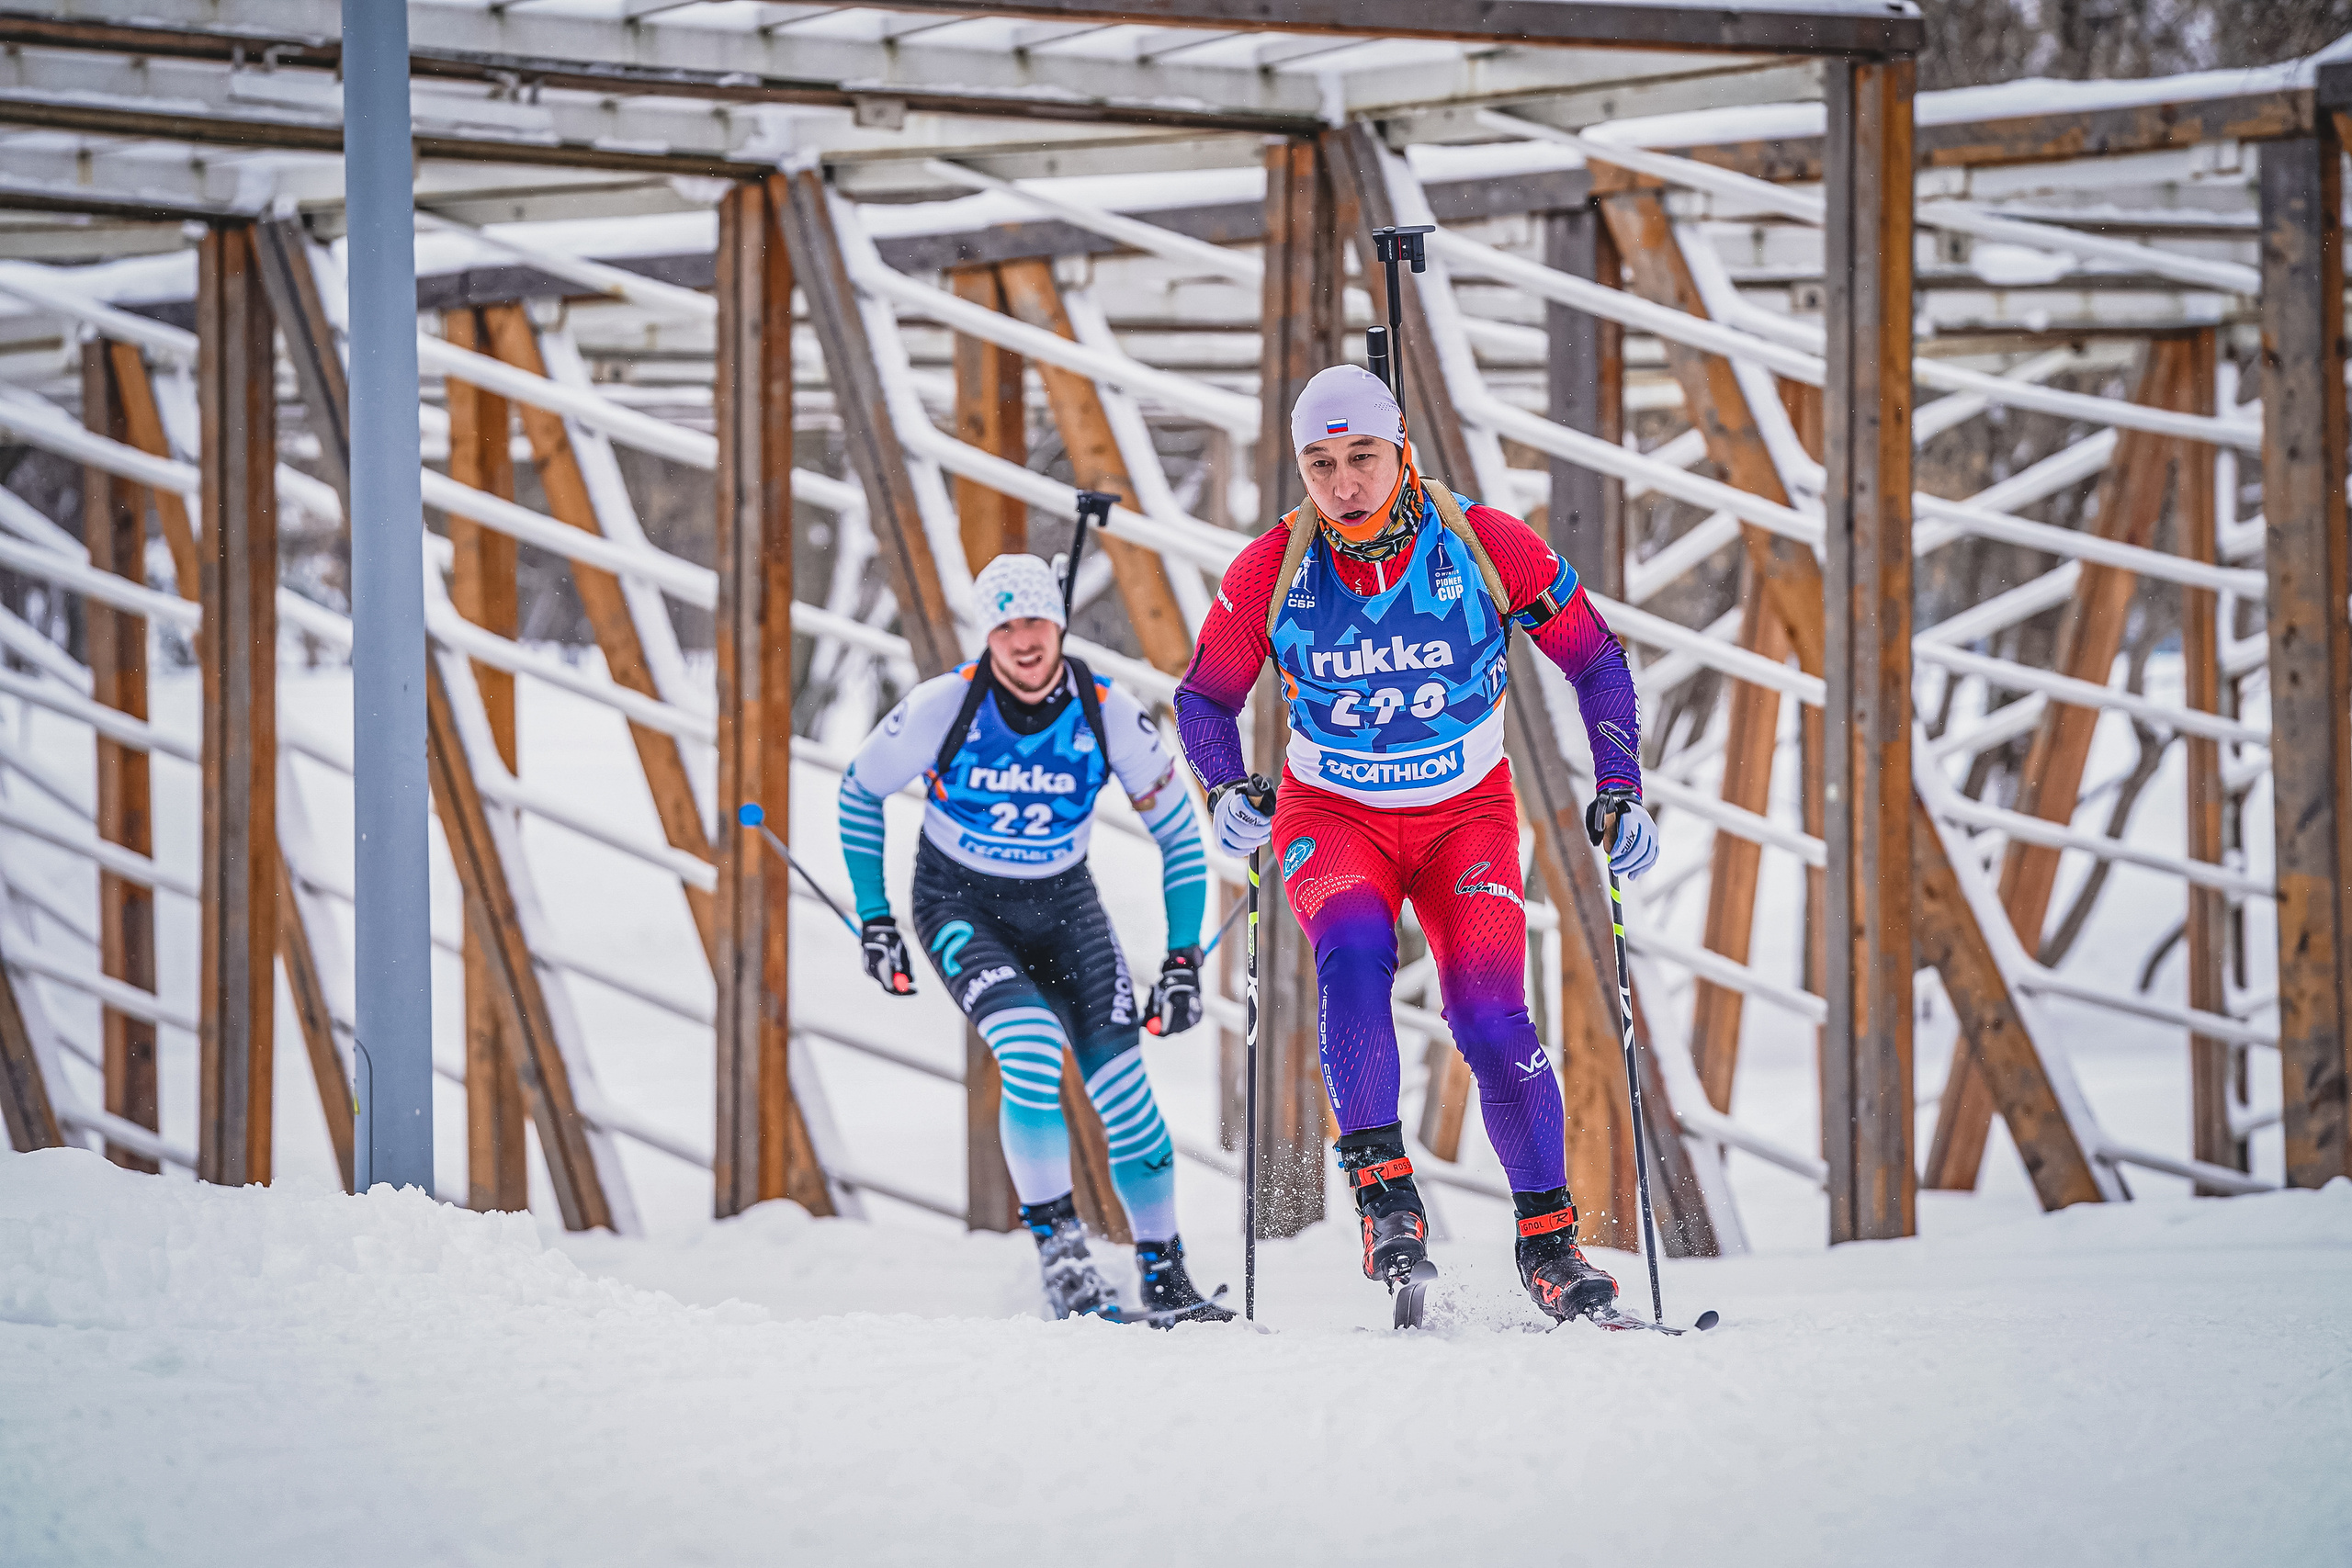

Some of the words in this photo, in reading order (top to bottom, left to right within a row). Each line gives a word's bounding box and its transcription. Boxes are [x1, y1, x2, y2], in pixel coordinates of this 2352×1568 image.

[1437, 584, 1464, 602] CUP
[1312, 635, 1454, 679] rukka
[968, 763, 1077, 795] rukka
[1326, 750, 1458, 784] DECATHLON
[989, 802, 1053, 836] 22
[1319, 984, 1329, 1055] VICTORY
[1323, 1063, 1341, 1109] CODE
